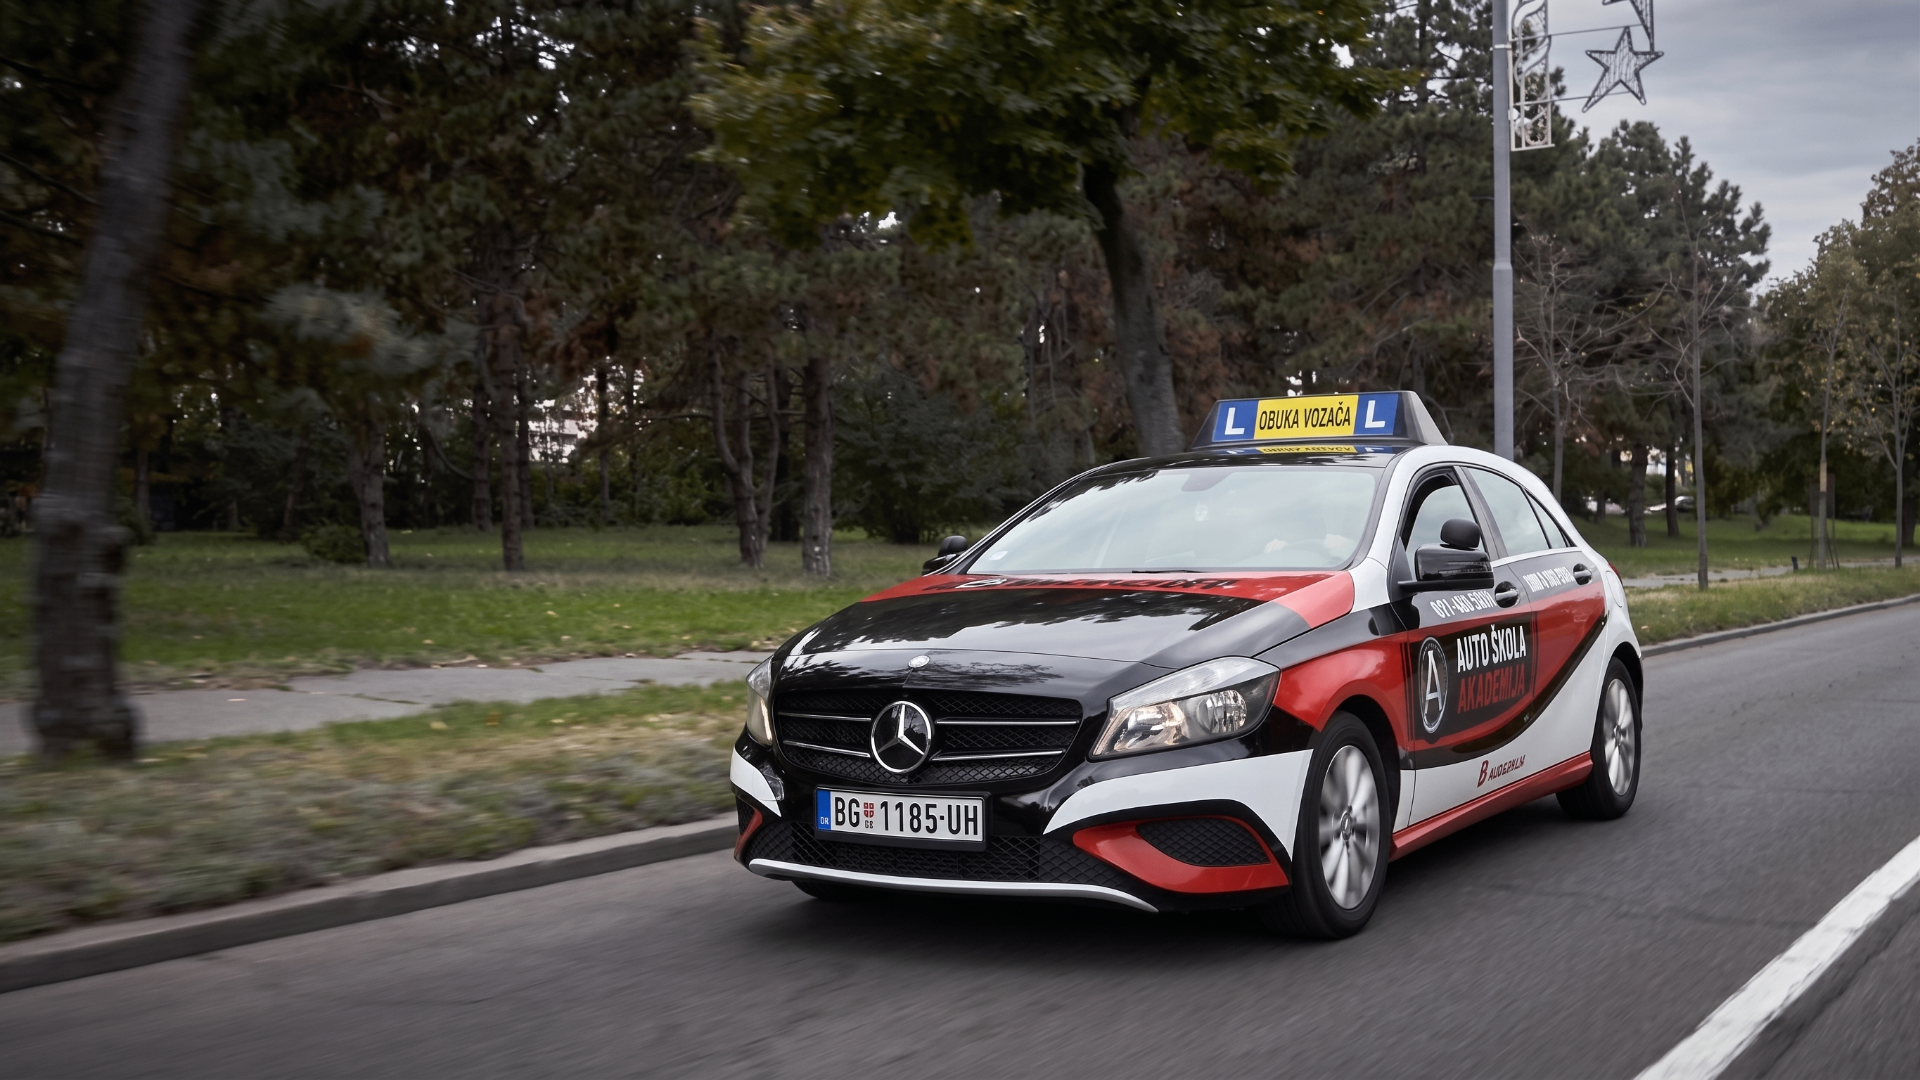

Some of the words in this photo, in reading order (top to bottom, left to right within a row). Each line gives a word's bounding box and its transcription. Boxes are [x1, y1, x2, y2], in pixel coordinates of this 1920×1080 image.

[1224, 407, 1245, 435] L
[1259, 408, 1300, 430] OBUKA
[1304, 401, 1351, 428] VOZAČA
[1364, 400, 1386, 429] L
[1456, 632, 1490, 673] AUTO
[1490, 624, 1527, 664] ŠKOLA
[1457, 662, 1526, 715] AKADEMIJA
[834, 796, 861, 828] BG
[880, 800, 979, 835] 1185-UH
